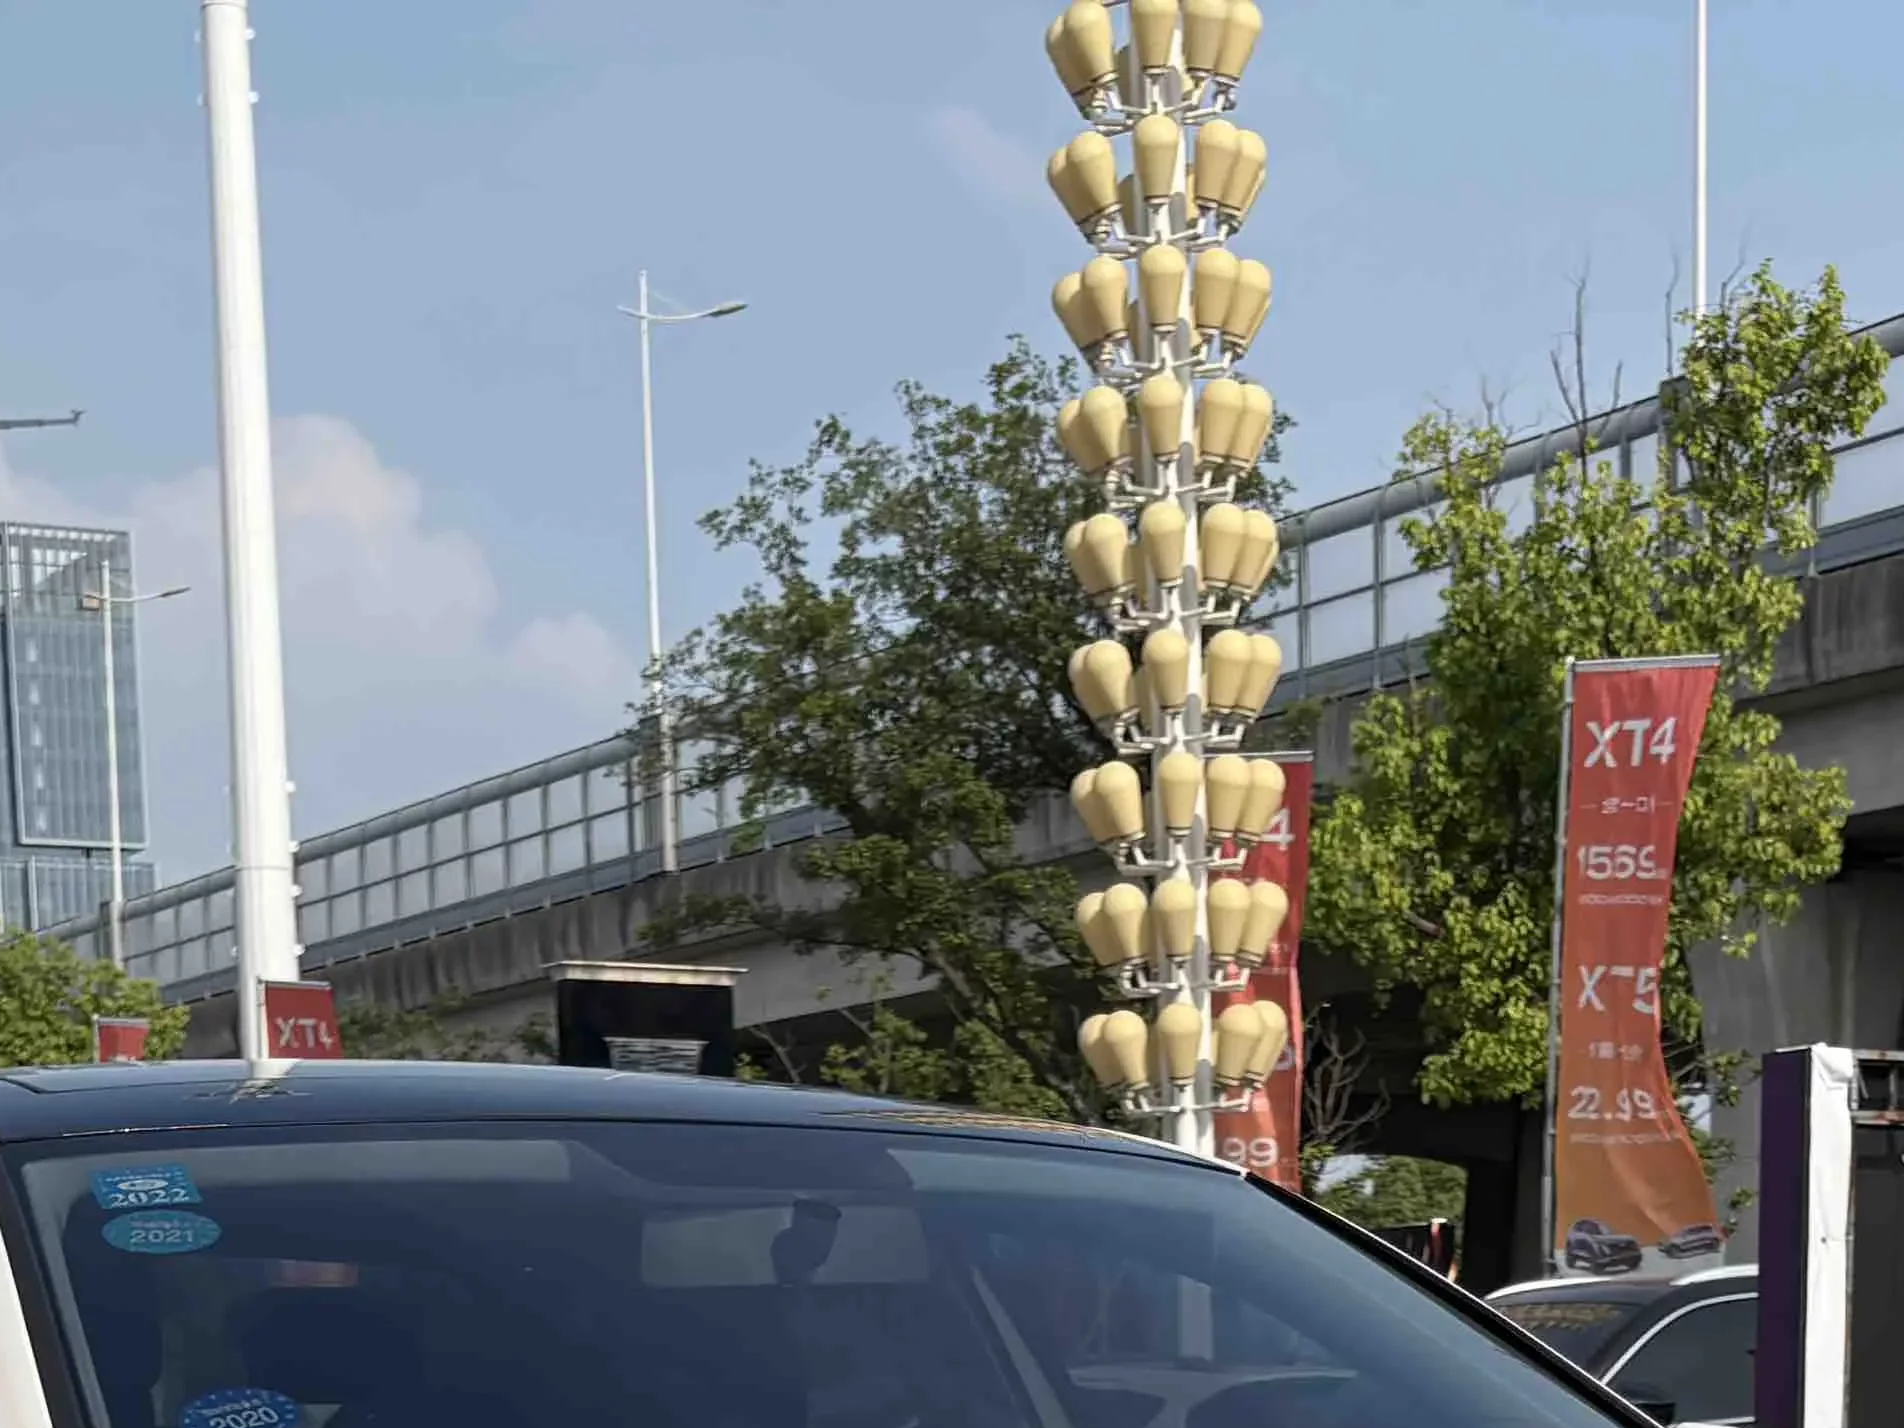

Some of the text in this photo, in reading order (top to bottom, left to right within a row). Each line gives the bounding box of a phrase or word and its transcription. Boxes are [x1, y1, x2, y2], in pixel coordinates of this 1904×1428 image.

[1583, 714, 1677, 769] XT4
[274, 1017, 336, 1050] XT4
[109, 1187, 191, 1208] 2022
[129, 1229, 194, 1243] 2021
